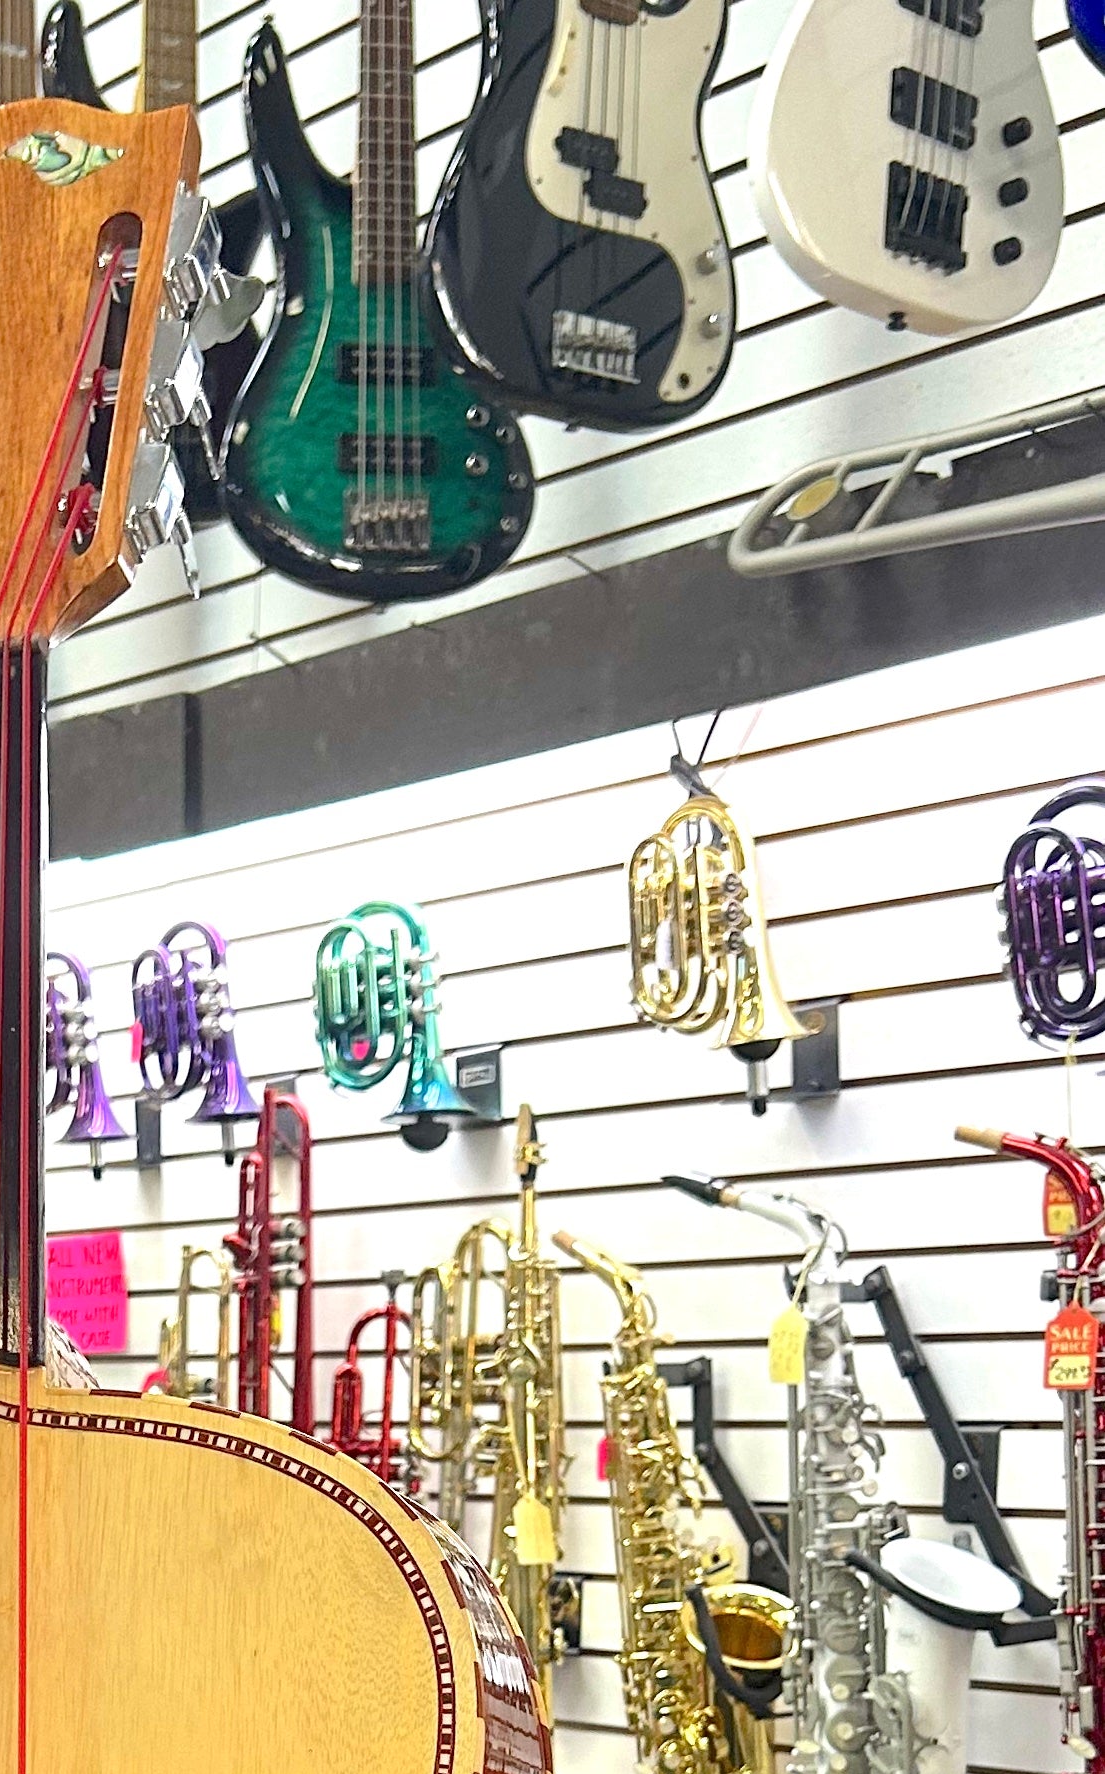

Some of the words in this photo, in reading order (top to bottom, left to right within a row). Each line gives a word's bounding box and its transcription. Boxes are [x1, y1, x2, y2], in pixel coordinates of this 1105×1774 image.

[83, 1240, 119, 1265] NEW
[1048, 1321, 1093, 1340] SALE
[1051, 1341, 1090, 1354] PRICE
